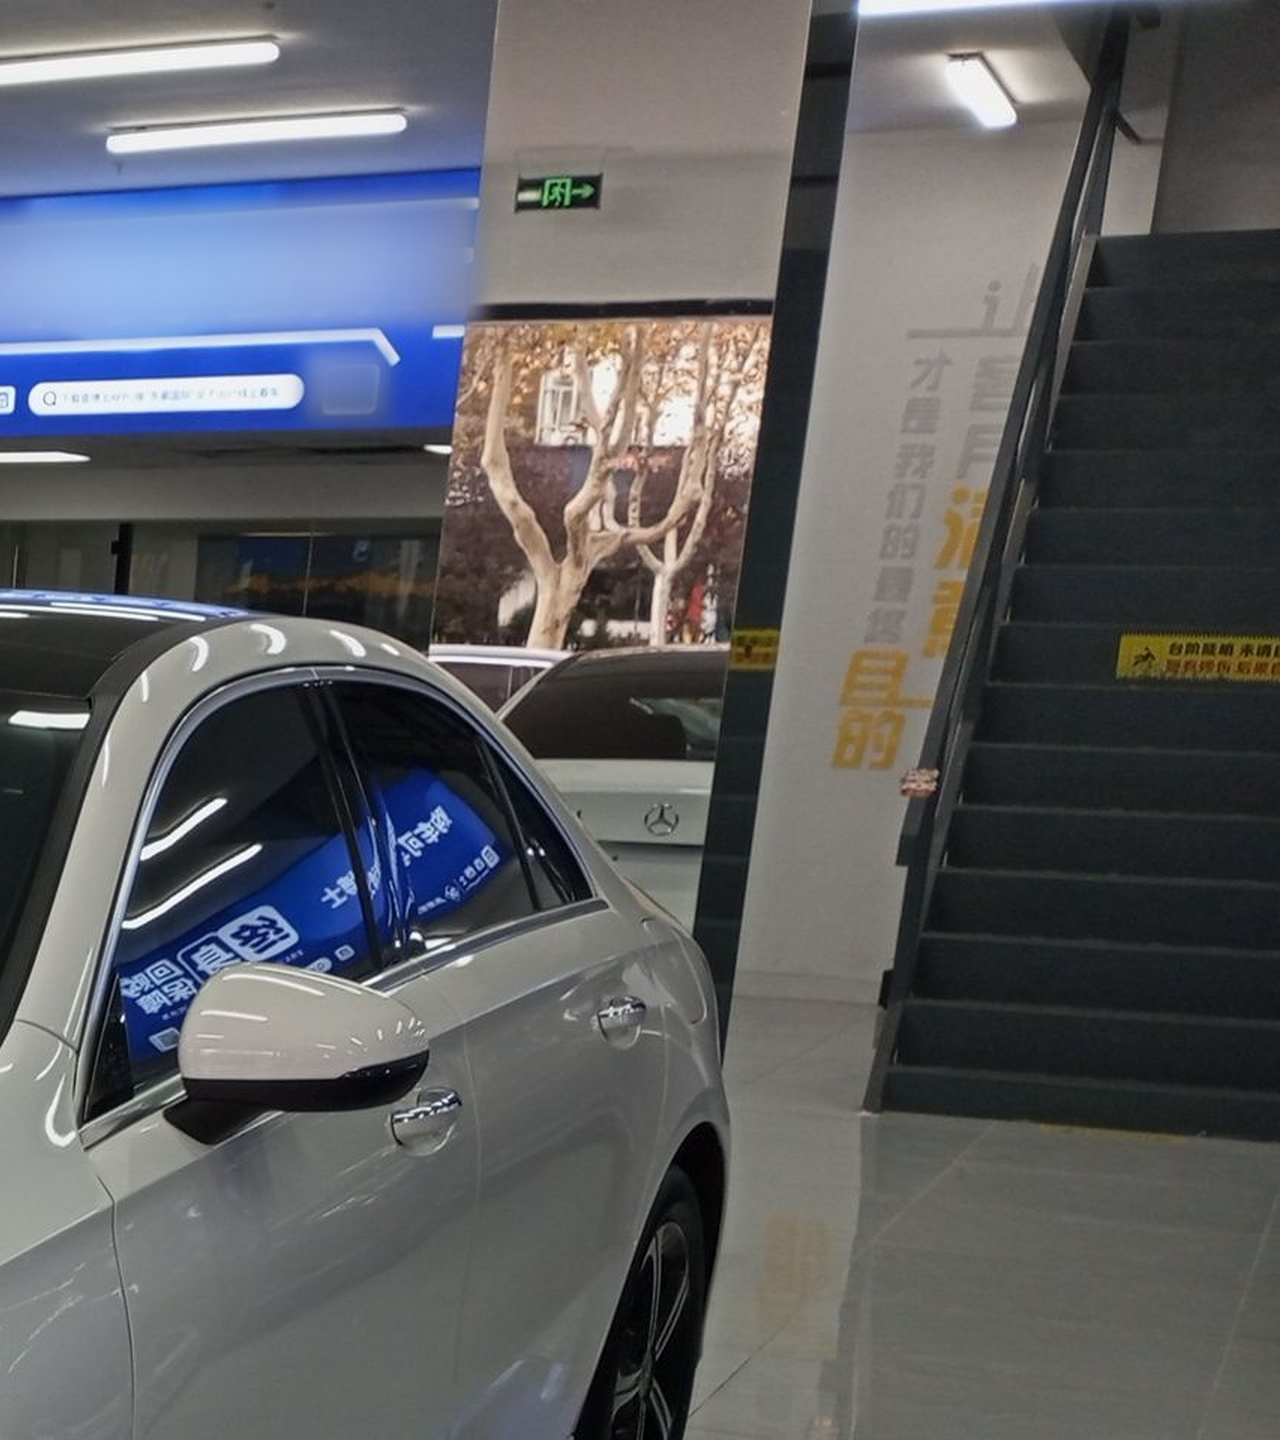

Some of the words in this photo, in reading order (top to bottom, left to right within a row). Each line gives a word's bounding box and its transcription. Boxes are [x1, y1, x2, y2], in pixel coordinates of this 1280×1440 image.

[832, 352, 953, 770] 才是我们的最终目的
